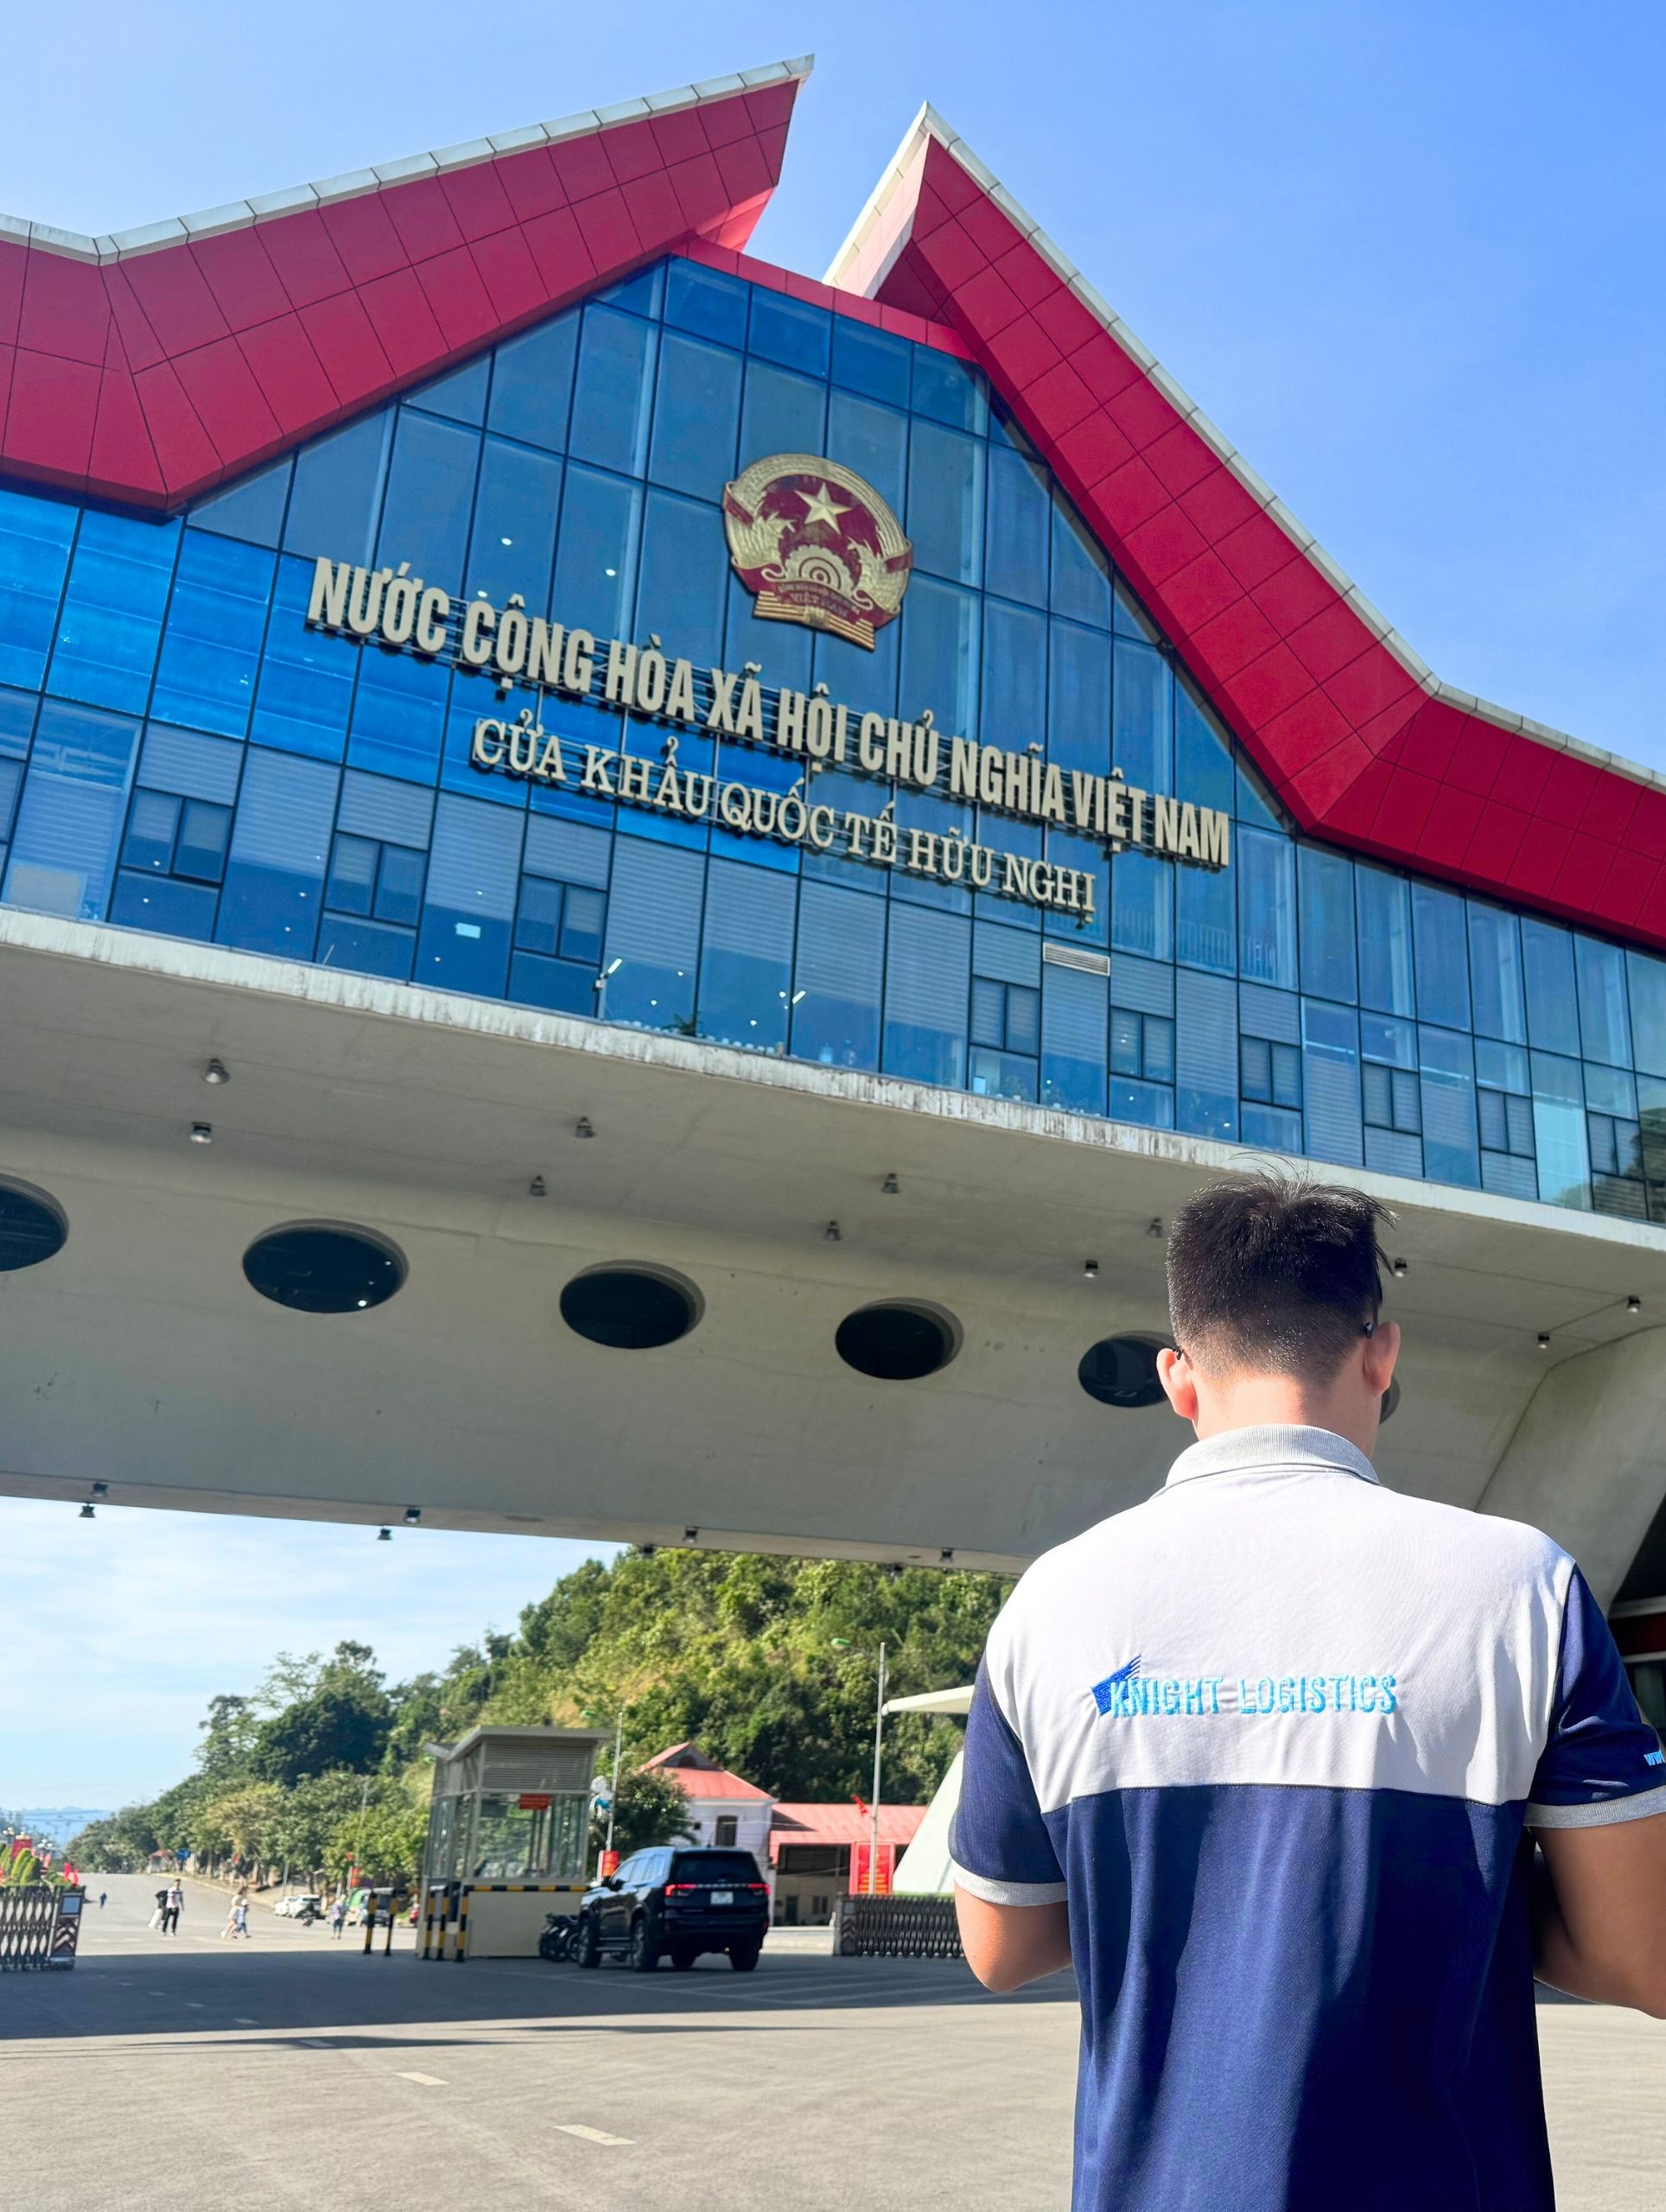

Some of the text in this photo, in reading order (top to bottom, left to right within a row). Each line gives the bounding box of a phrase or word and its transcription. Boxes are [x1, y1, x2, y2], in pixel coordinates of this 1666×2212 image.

[307, 556, 1230, 868] NƯỚC CỘNG HÒA XÃ HỘI CHỦ NGHĨA VIỆT NAM
[474, 709, 1097, 925] CỬA KHẨU QUỐC TẾ HỮU NGHỊ
[1110, 1673, 1397, 1719] KNIGHT LOGISTICS
